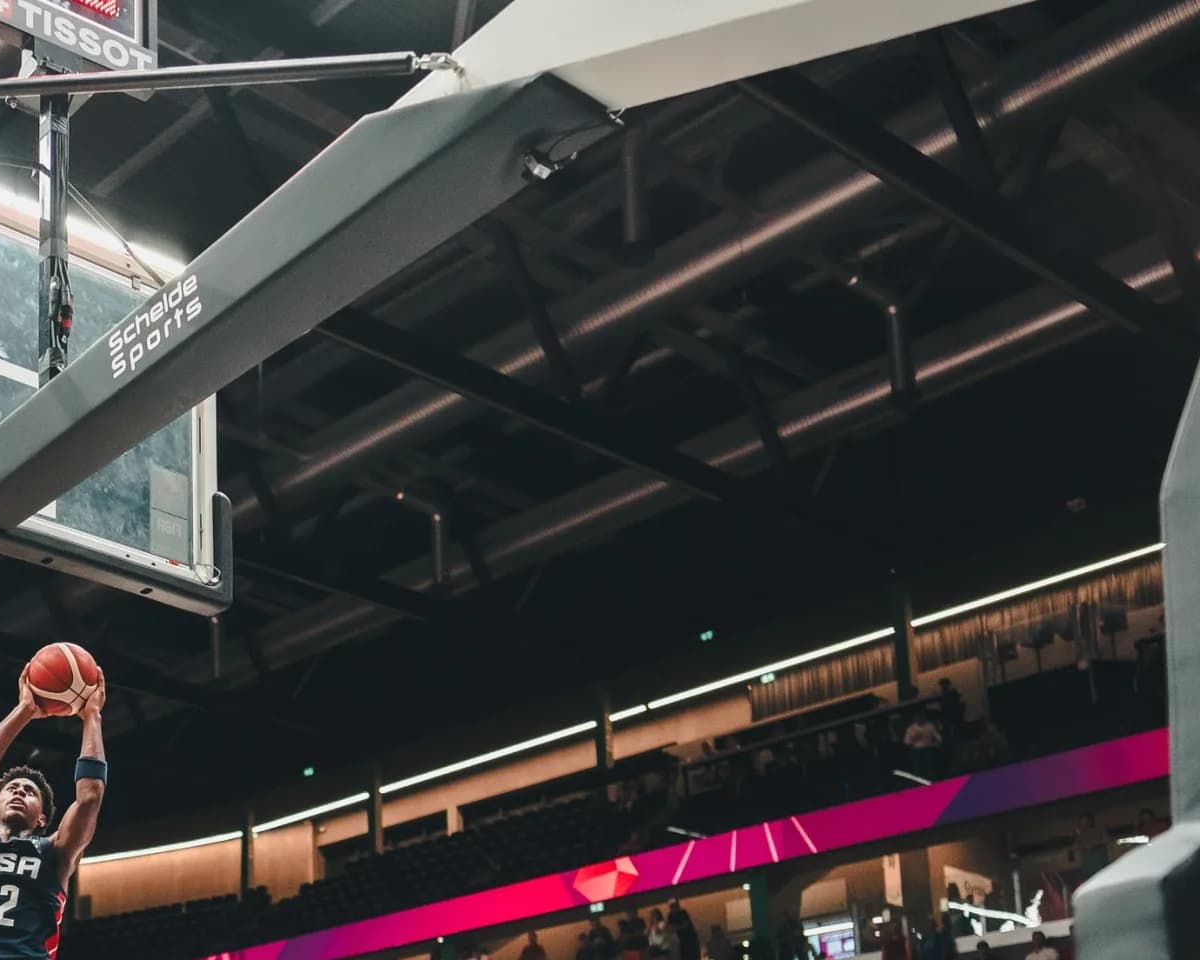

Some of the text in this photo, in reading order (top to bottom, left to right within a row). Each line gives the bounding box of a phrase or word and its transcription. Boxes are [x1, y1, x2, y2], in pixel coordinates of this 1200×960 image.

[17, 1, 153, 70] TISSOT
[109, 274, 198, 357] Schelde
[111, 295, 202, 379] Sports
